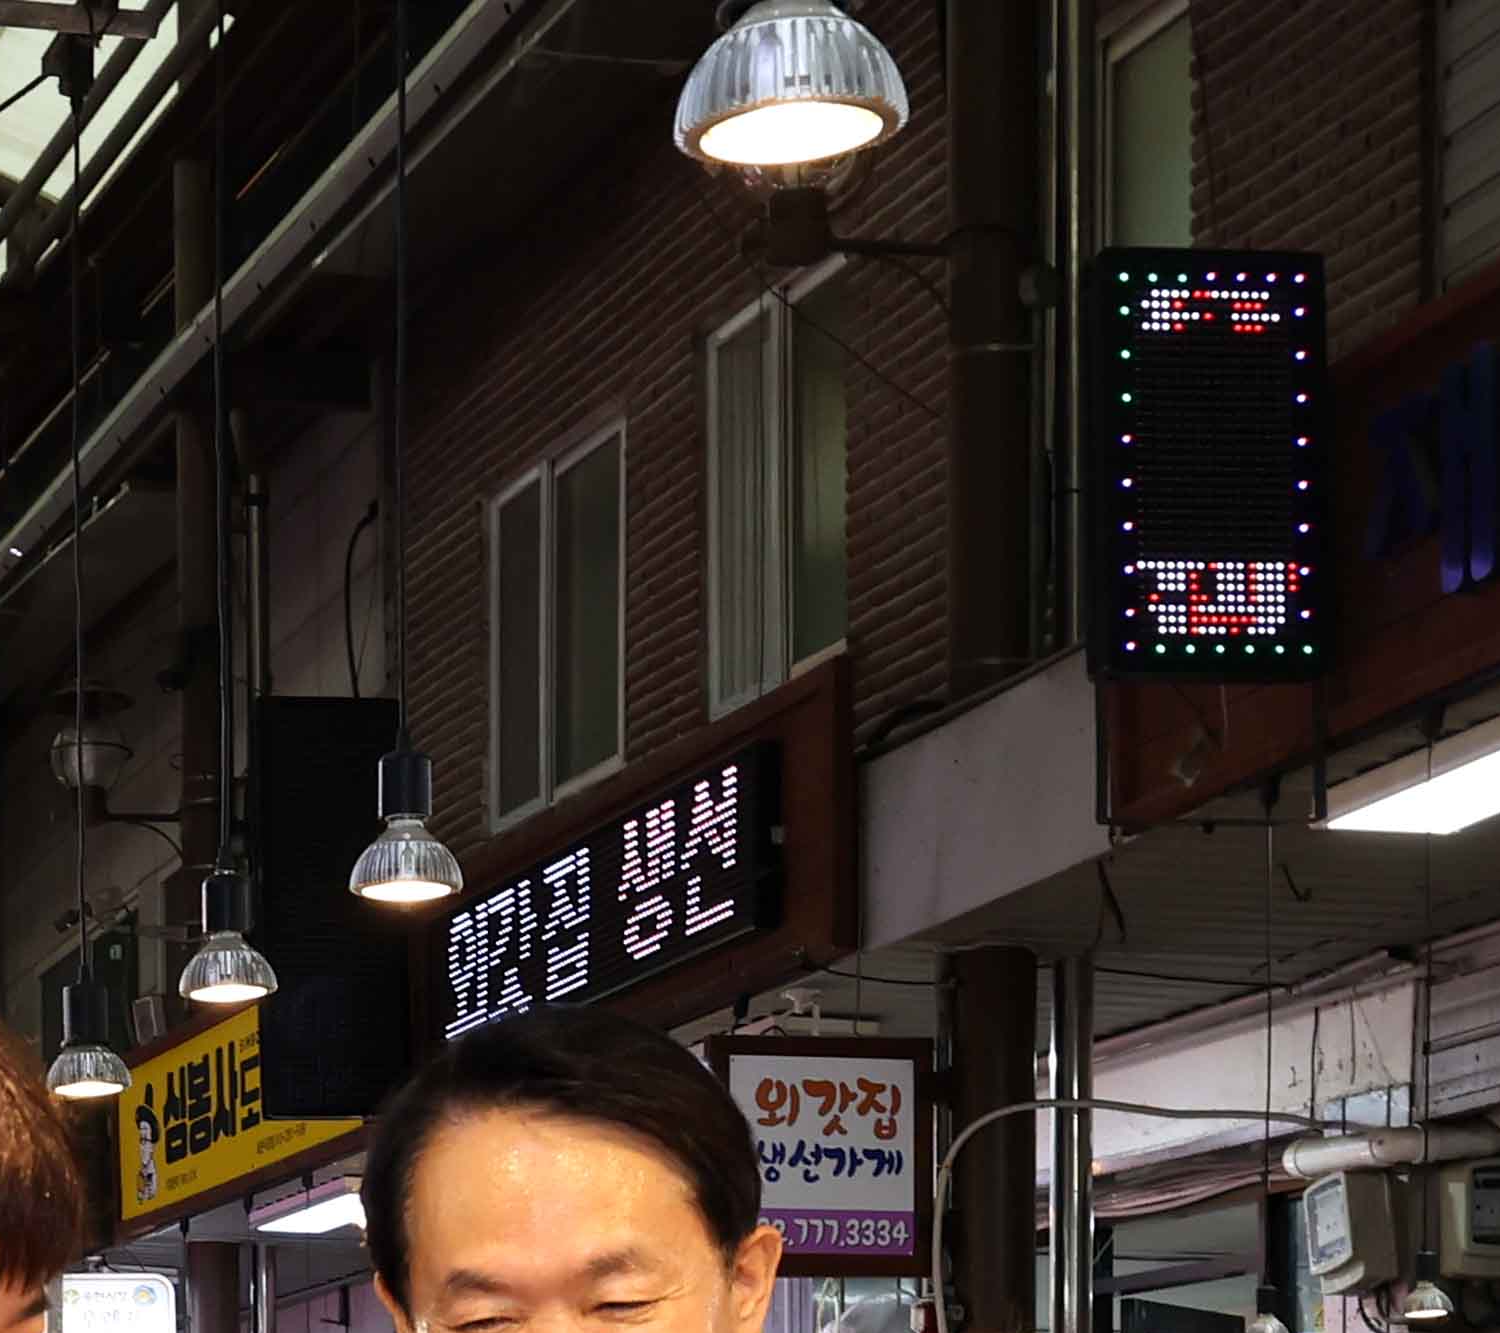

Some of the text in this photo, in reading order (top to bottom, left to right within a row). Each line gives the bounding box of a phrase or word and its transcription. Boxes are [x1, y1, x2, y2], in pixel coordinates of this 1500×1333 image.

[618, 766, 738, 960] 생선
[755, 1077, 902, 1140] 외갓집
[757, 1139, 904, 1183] 생선가게
